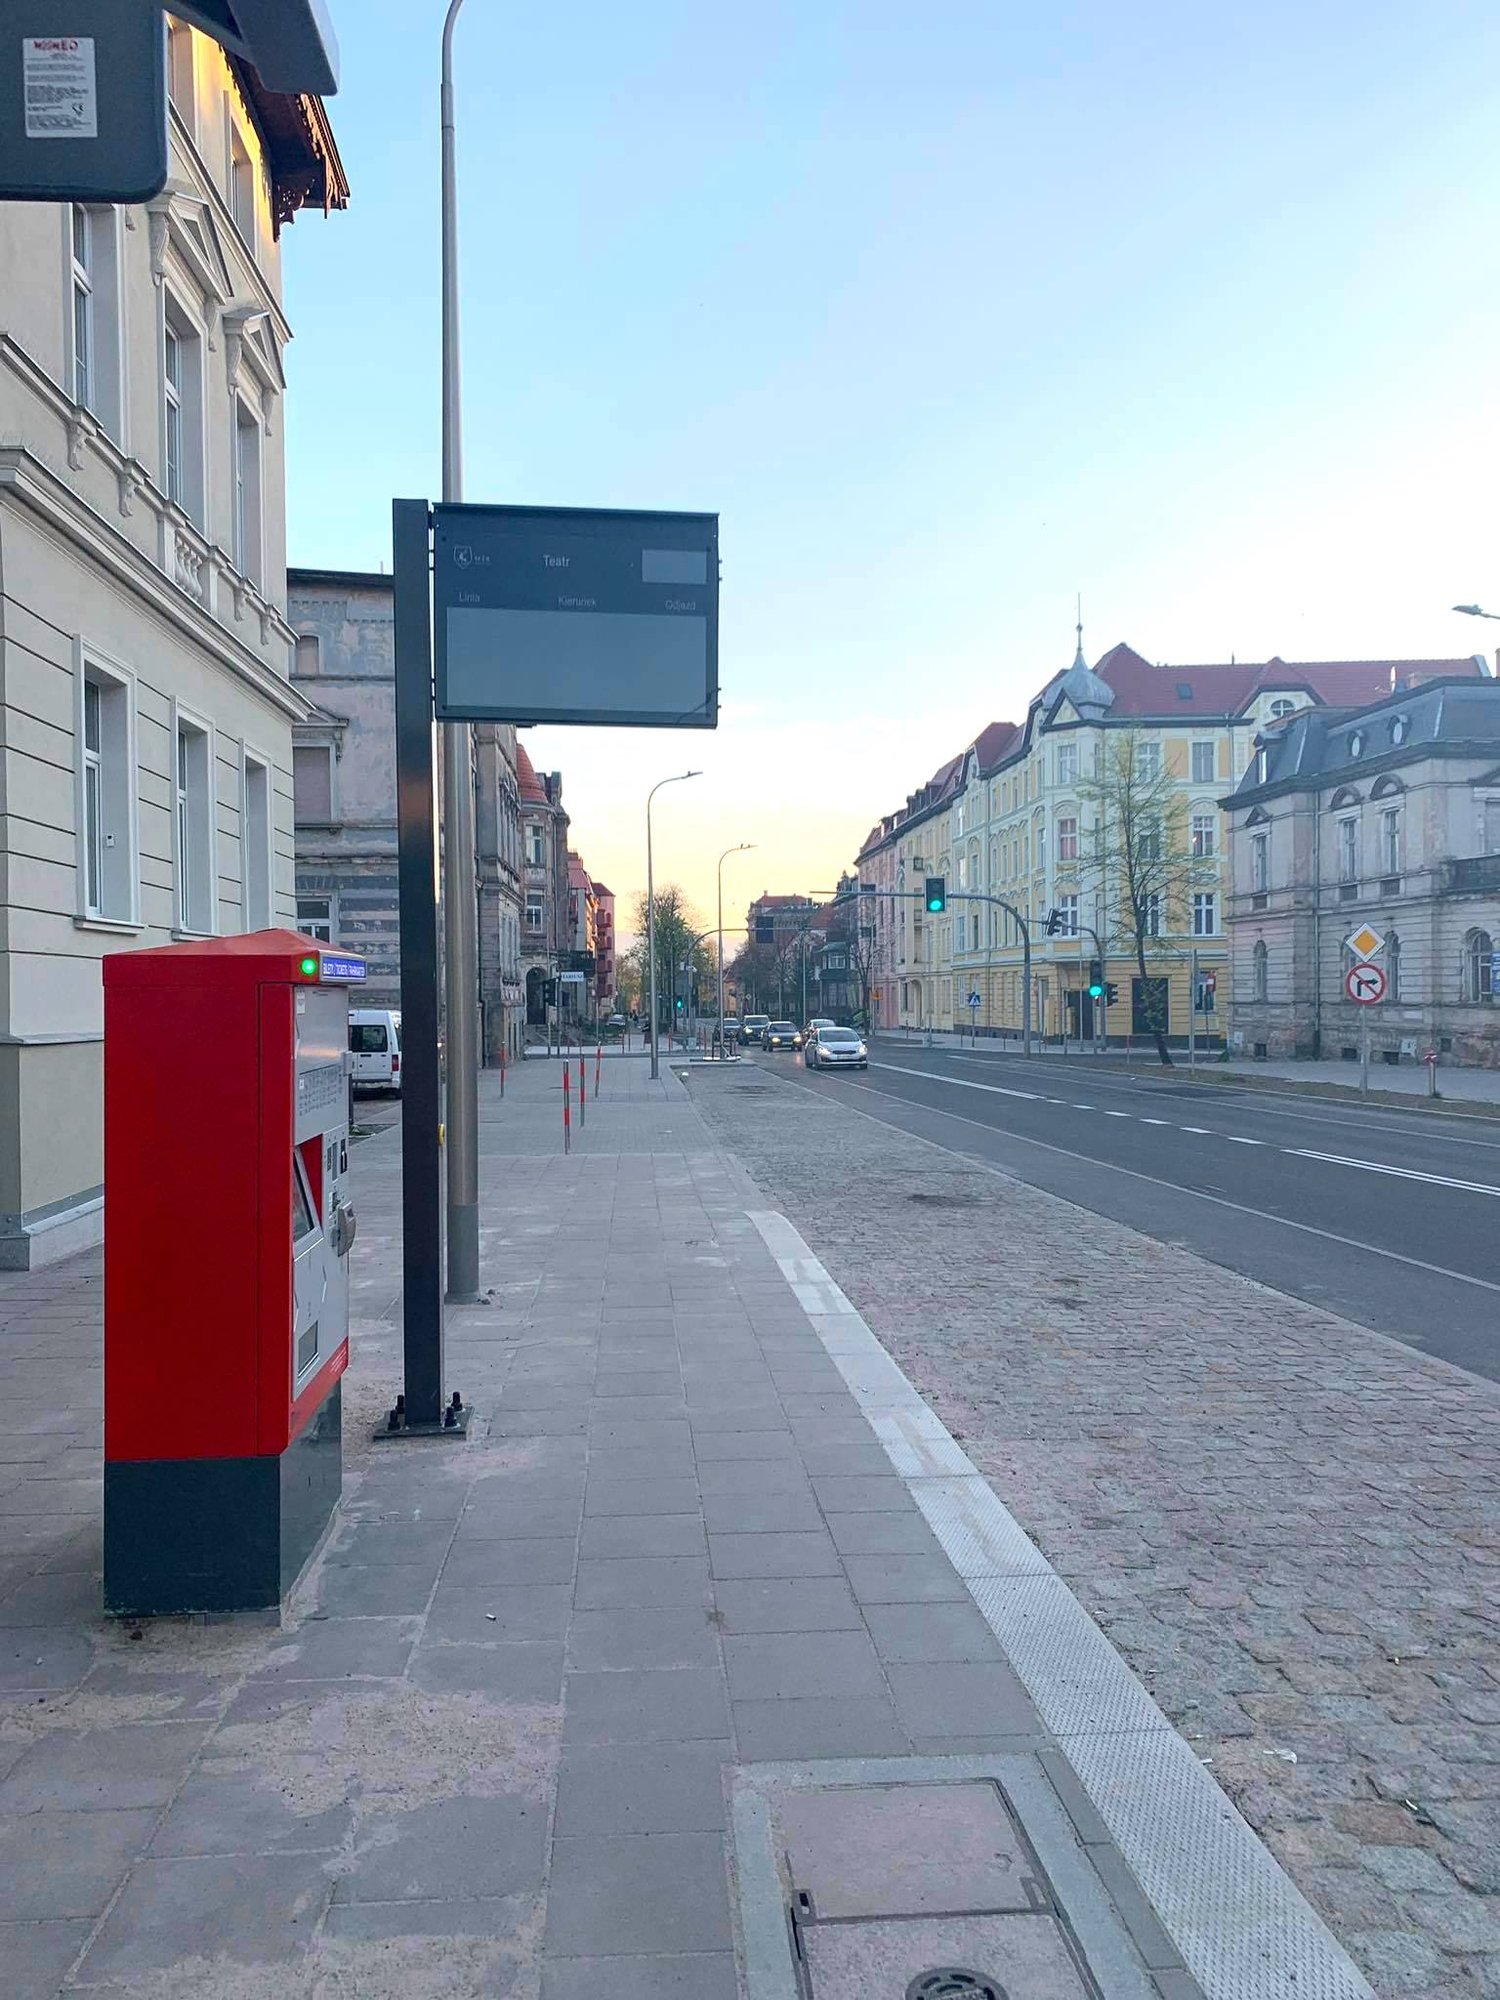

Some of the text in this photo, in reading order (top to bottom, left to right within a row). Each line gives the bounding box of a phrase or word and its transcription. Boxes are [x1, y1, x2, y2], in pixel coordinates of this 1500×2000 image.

[543, 554, 571, 567] Teatr
[459, 592, 696, 612] Linia Kierunek Odjazd
